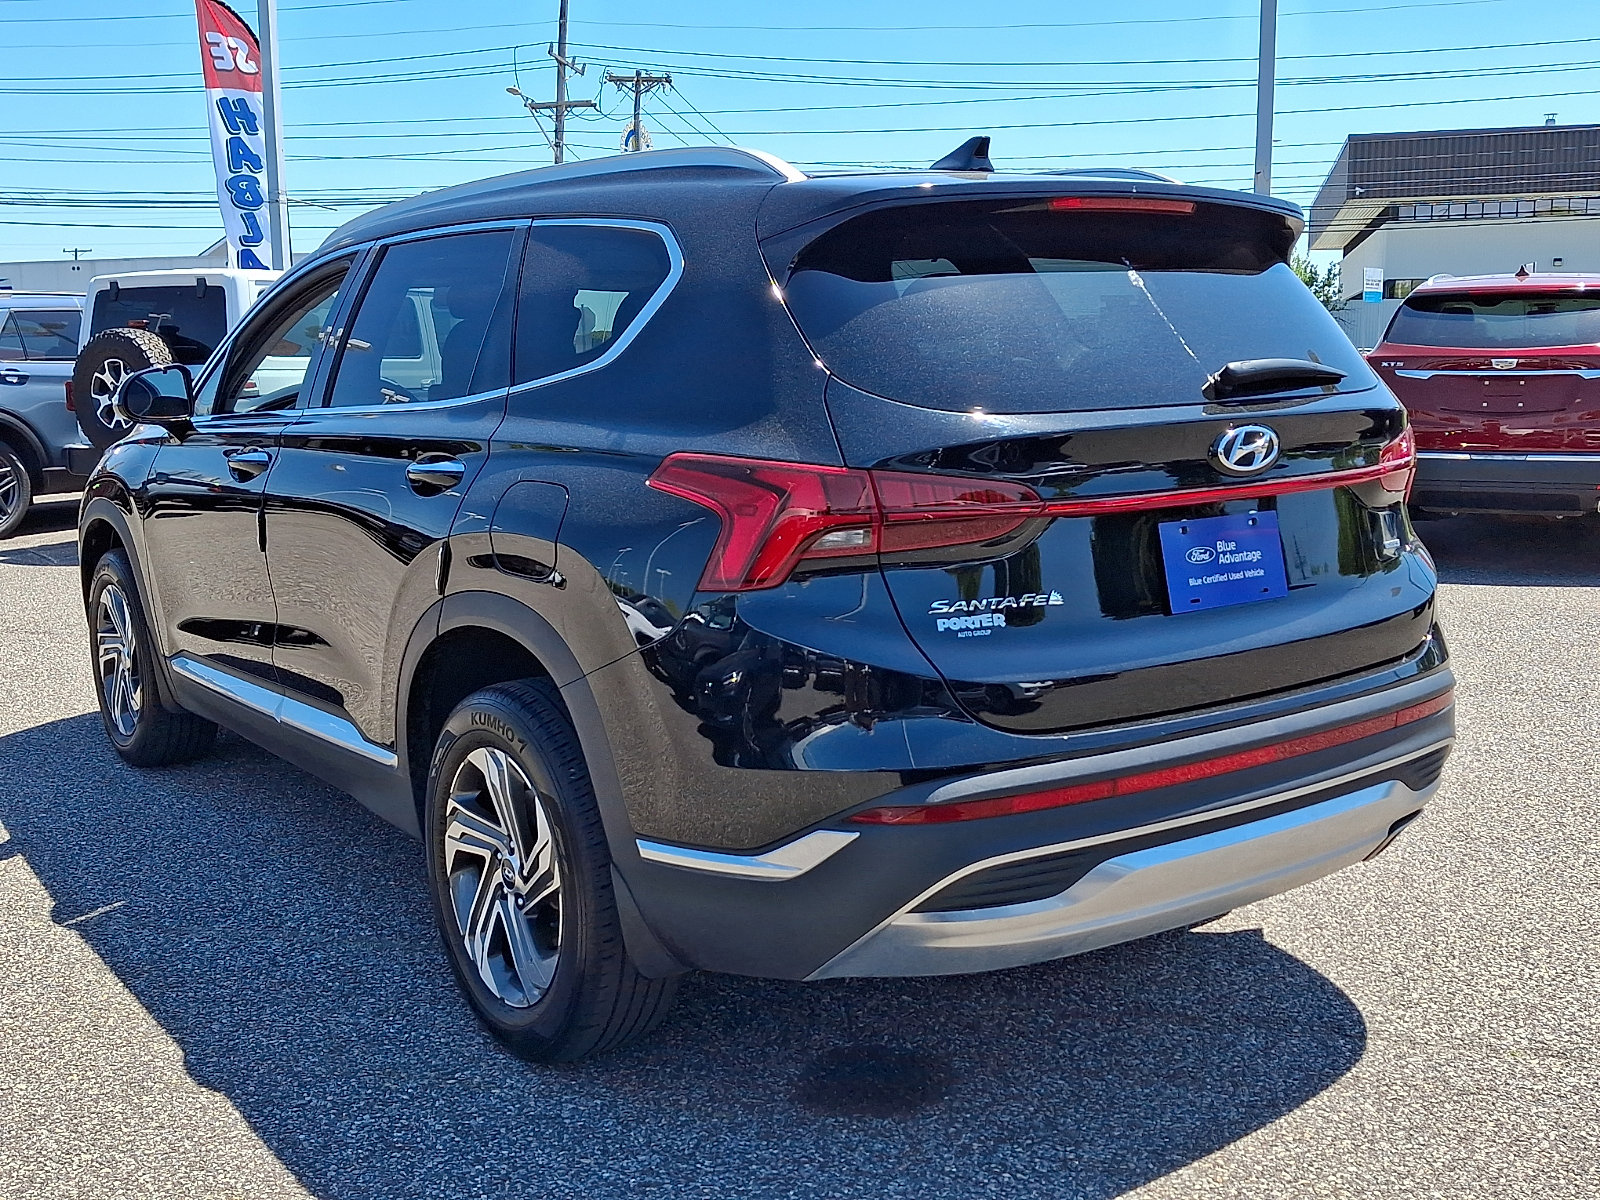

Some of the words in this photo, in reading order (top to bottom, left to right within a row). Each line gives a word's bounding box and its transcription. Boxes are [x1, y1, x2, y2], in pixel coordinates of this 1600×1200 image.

[1216, 540, 1237, 552] Blue
[1190, 549, 1210, 562] Ford
[1218, 550, 1262, 565] Advantage
[1188, 577, 1203, 587] Blue
[1202, 573, 1229, 585] Certified
[1228, 571, 1245, 581] Used
[1244, 568, 1265, 579] Vehicle
[937, 613, 1006, 632] PORTER
[957, 630, 973, 638] AUTO
[973, 629, 992, 637] GROUP
[471, 711, 515, 743] KUMHO
